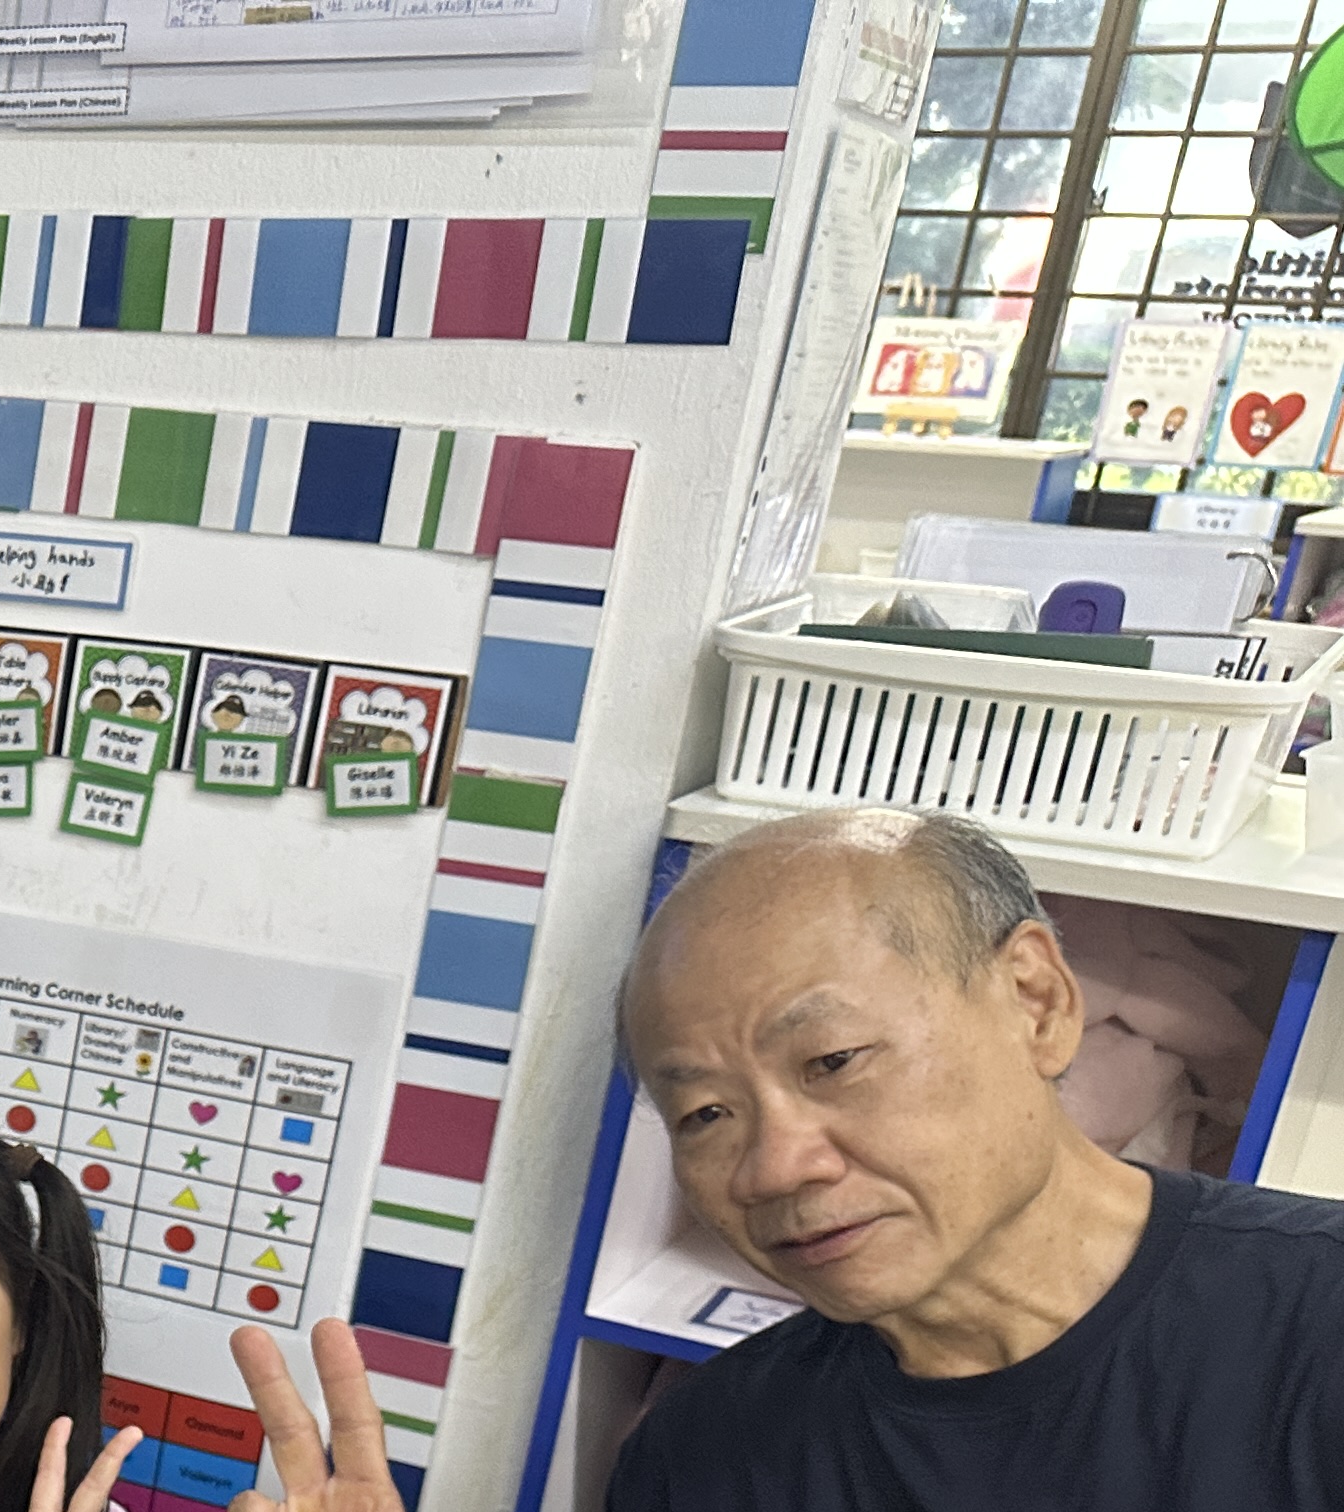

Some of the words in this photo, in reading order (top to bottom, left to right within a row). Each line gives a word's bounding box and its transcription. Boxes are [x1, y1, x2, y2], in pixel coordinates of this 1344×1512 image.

[47, 546, 95, 567] hands
[45, 982, 103, 1007] Corner
[106, 993, 185, 1022] Schedule
